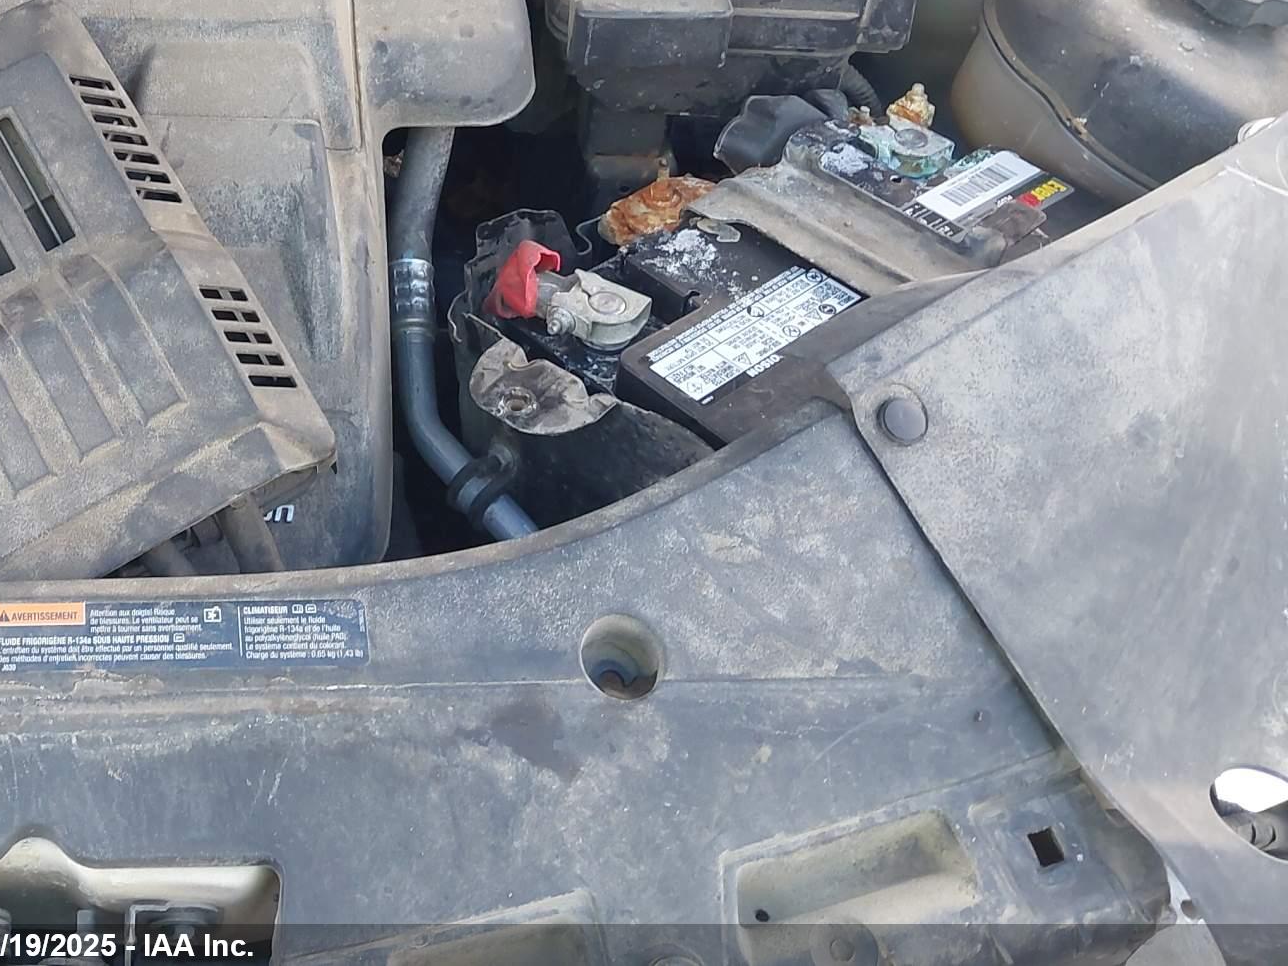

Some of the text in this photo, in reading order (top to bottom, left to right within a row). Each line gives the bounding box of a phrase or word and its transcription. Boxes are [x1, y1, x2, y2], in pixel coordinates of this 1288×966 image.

[243, 606, 288, 614] CLIMATISEUR
[11, 611, 78, 621] AVERTISSEMENT
[93, 635, 111, 644] SOUS
[112, 635, 134, 643] HAUTE
[136, 635, 169, 643] PRESSION
[246, 642, 253, 650] Le
[246, 651, 268, 660] Charge
